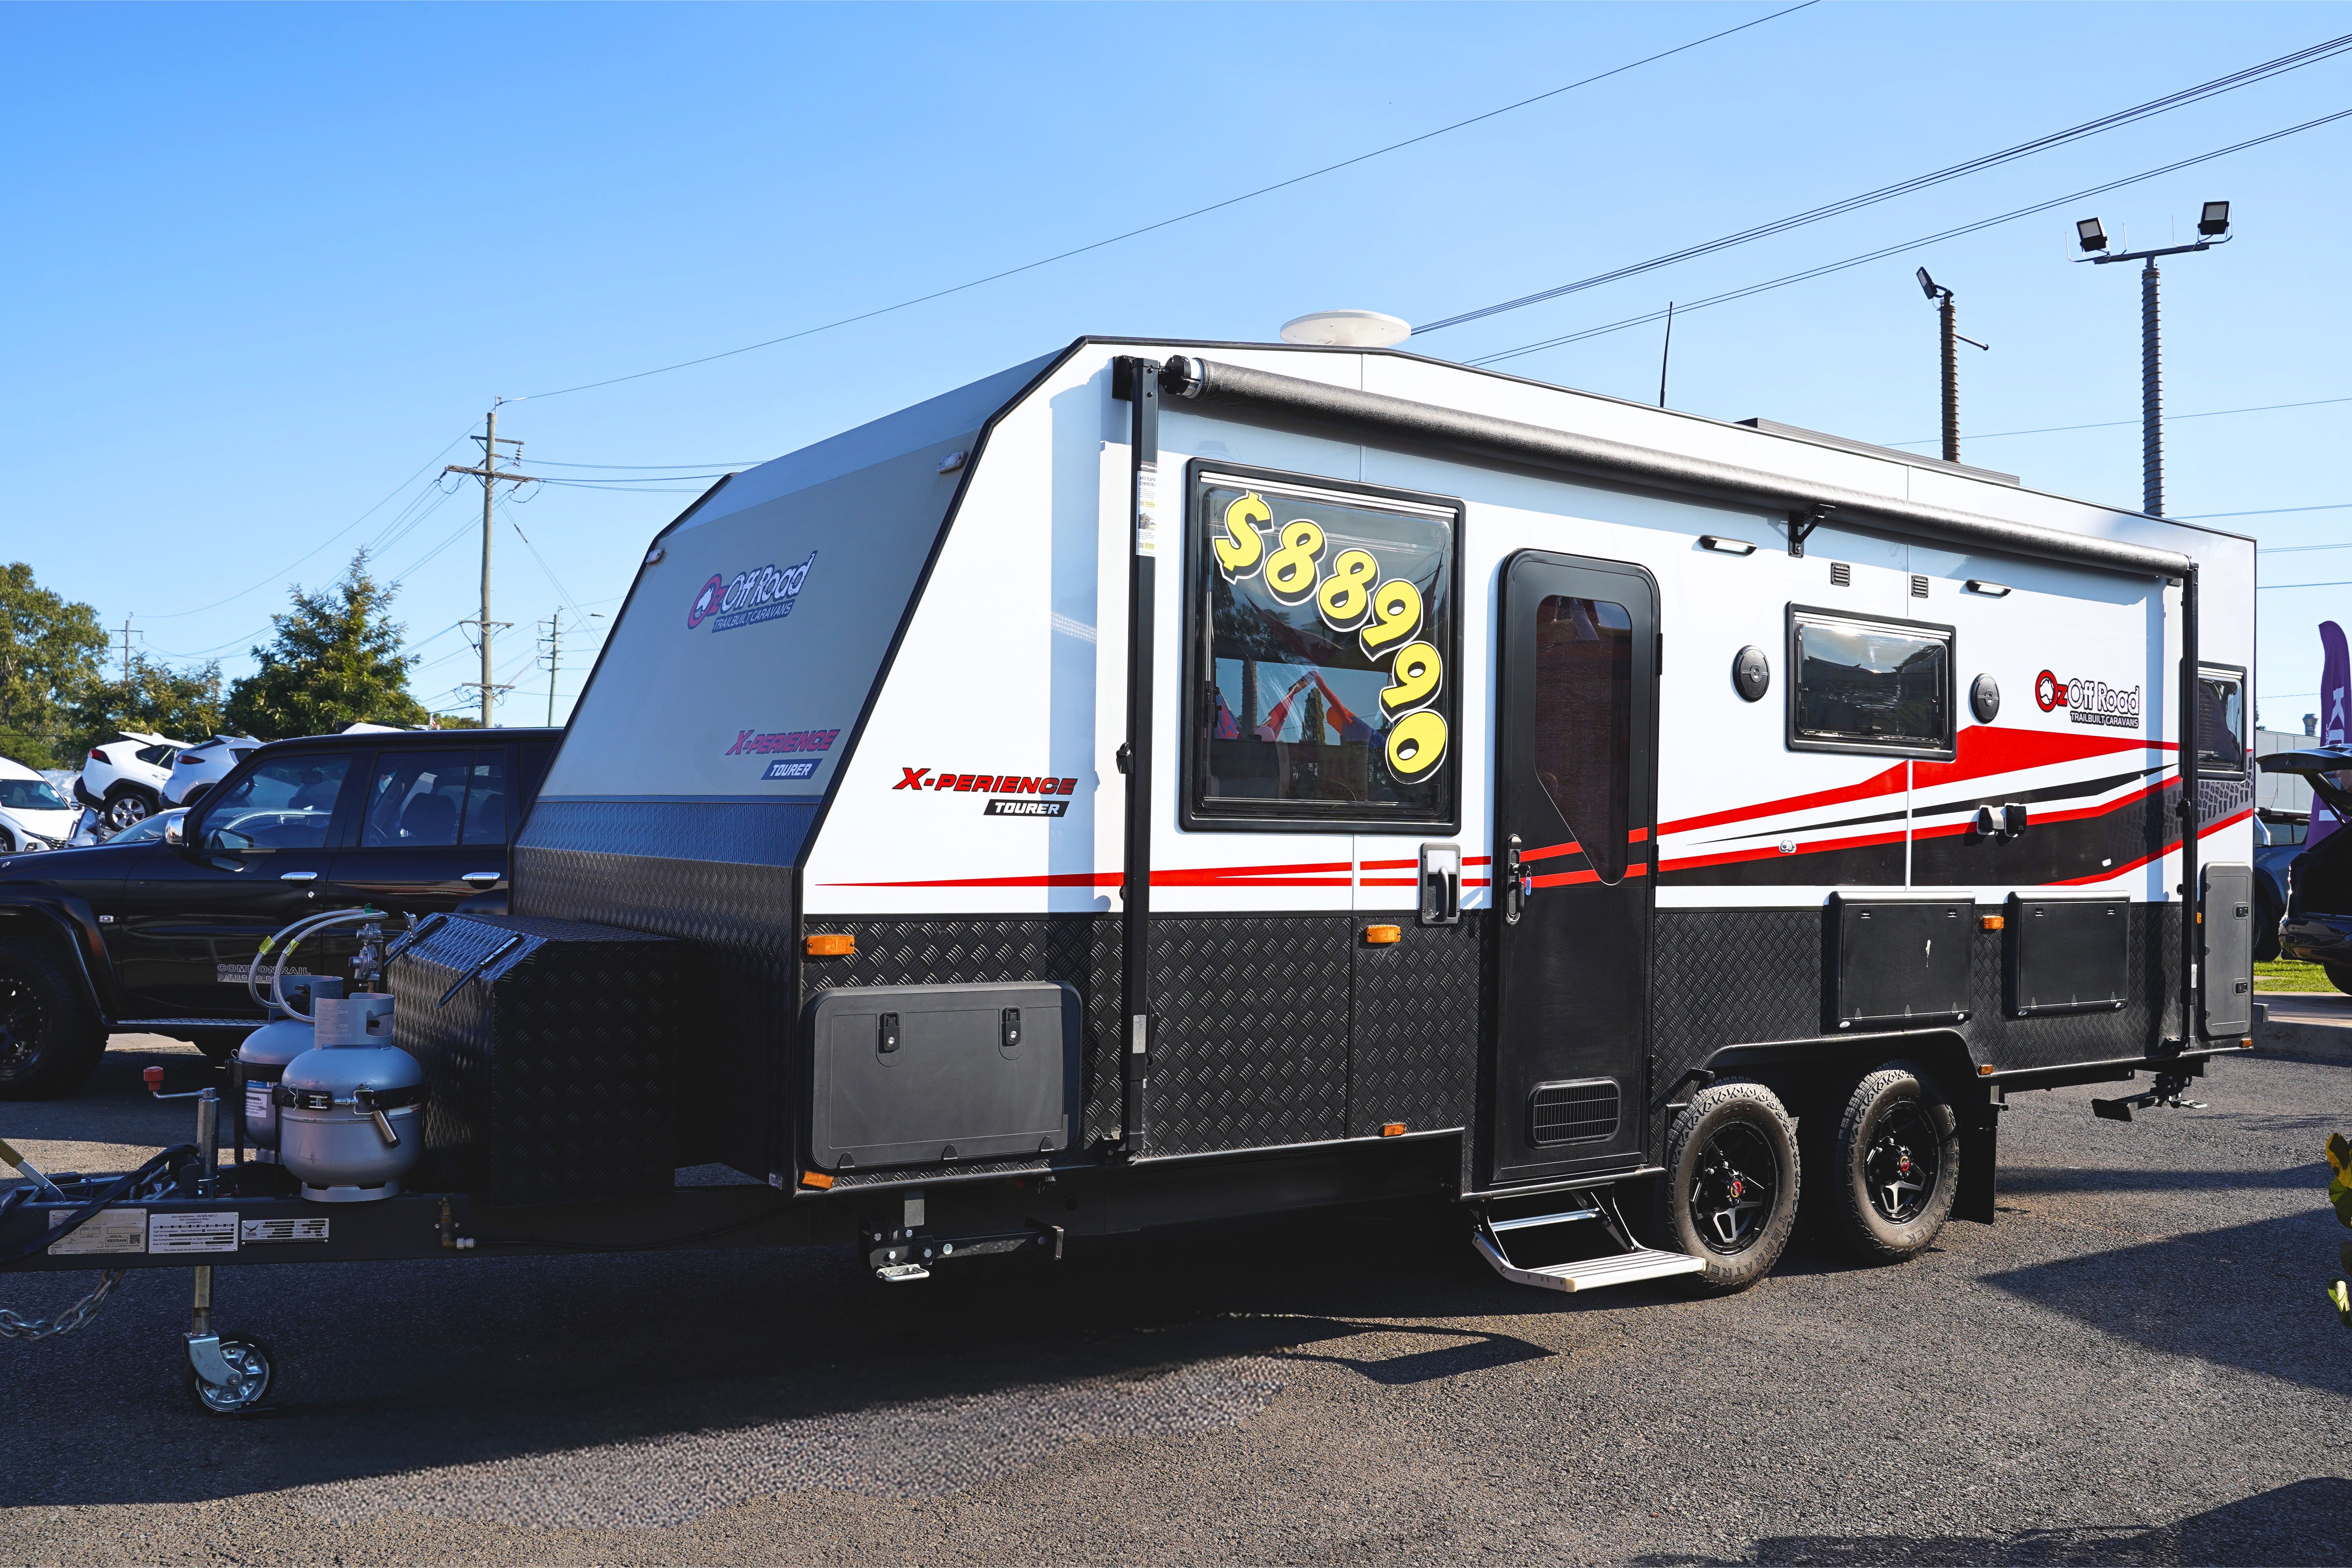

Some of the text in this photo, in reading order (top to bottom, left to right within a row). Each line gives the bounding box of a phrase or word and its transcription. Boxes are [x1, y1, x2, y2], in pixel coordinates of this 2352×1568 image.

[720, 568, 760, 613] Off
[749, 550, 818, 605] Road
[712, 601, 793, 632] TRAILBUILT CARAVANS
[1212, 490, 1448, 784] $88990
[2067, 678, 2095, 710] Off
[2098, 682, 2140, 715] Road
[2070, 711, 2139, 729] TRAILBUILT CARAVANS
[725, 729, 841, 756] X-PERIENCE
[769, 763, 813, 776] TOURER
[892, 767, 1078, 795] X-PERIENCE
[995, 802, 1060, 815] TOURER
[217, 964, 275, 974] COMON
